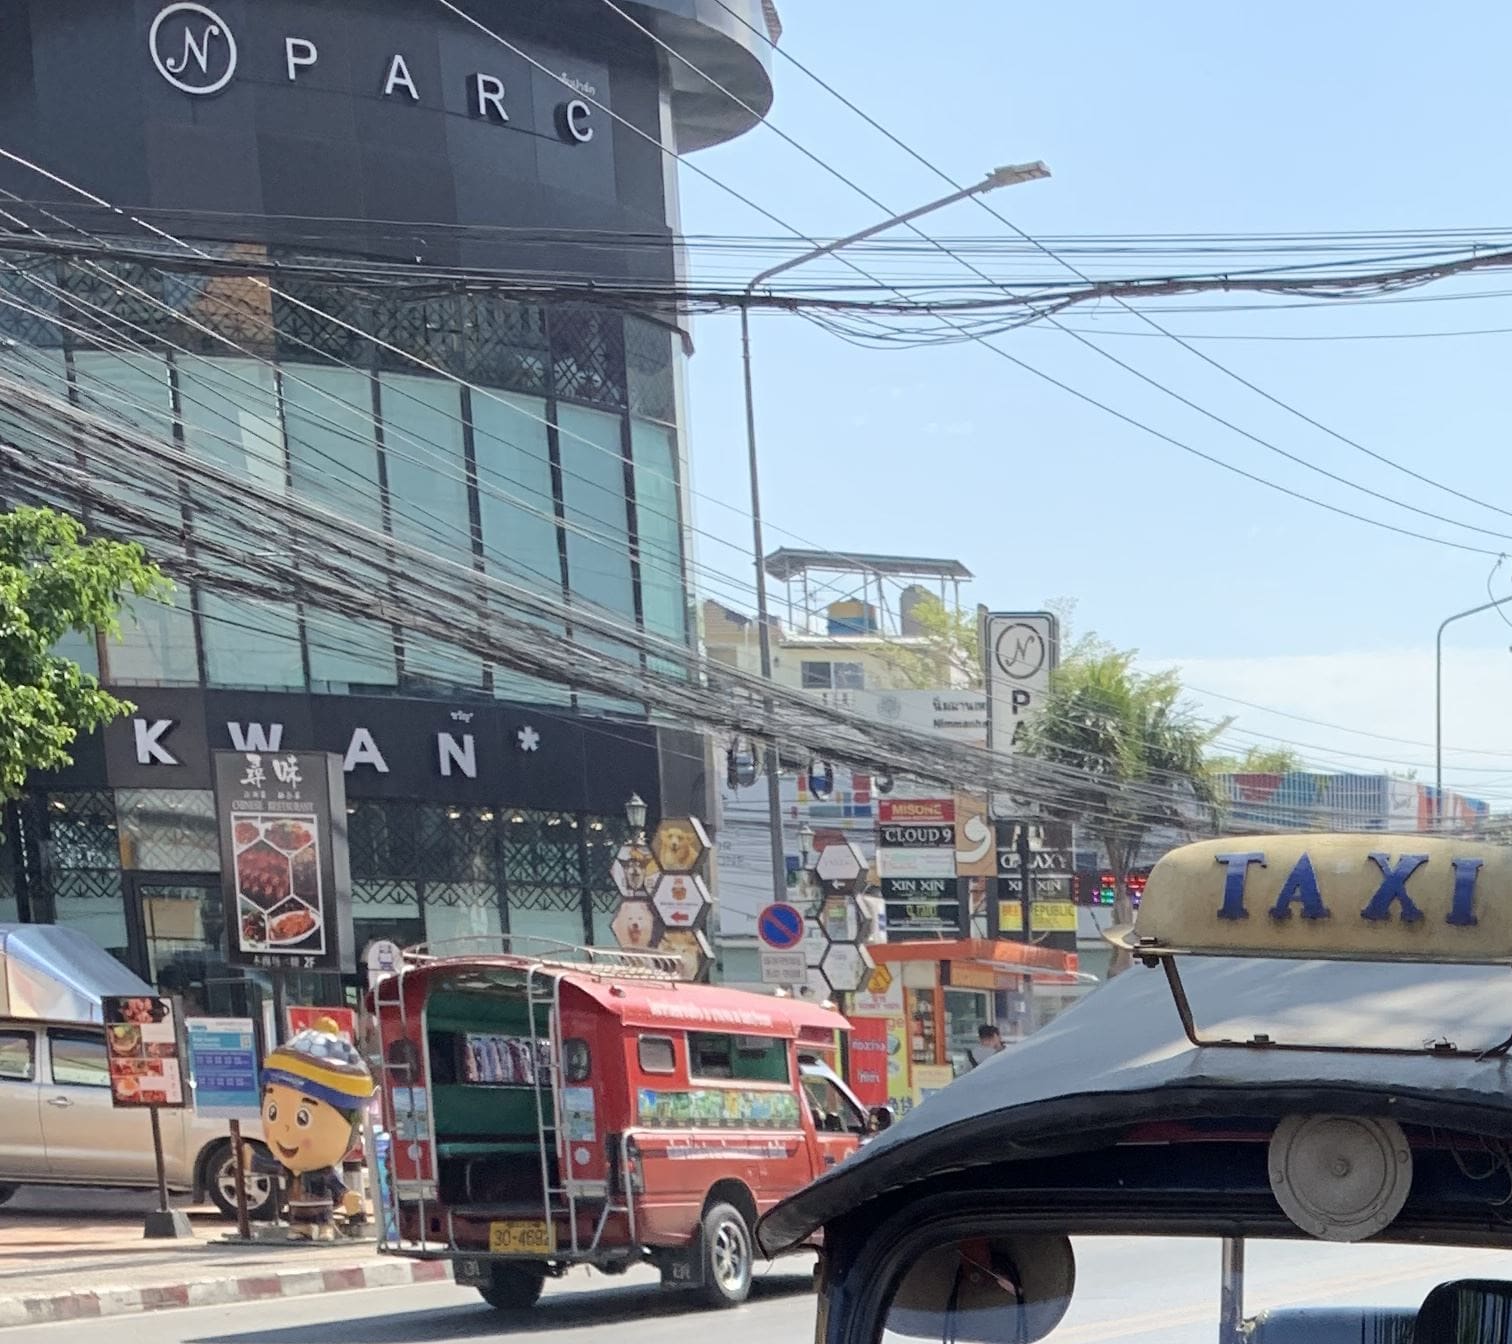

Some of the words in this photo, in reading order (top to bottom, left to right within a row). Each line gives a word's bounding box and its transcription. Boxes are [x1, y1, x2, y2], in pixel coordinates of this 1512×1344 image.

[285, 37, 594, 144] PARC
[884, 827, 938, 844] CLOUD
[942, 828, 953, 844] 9
[891, 879, 916, 892] XIN
[919, 879, 945, 892] XIN
[1214, 850, 1485, 928] TAXI
